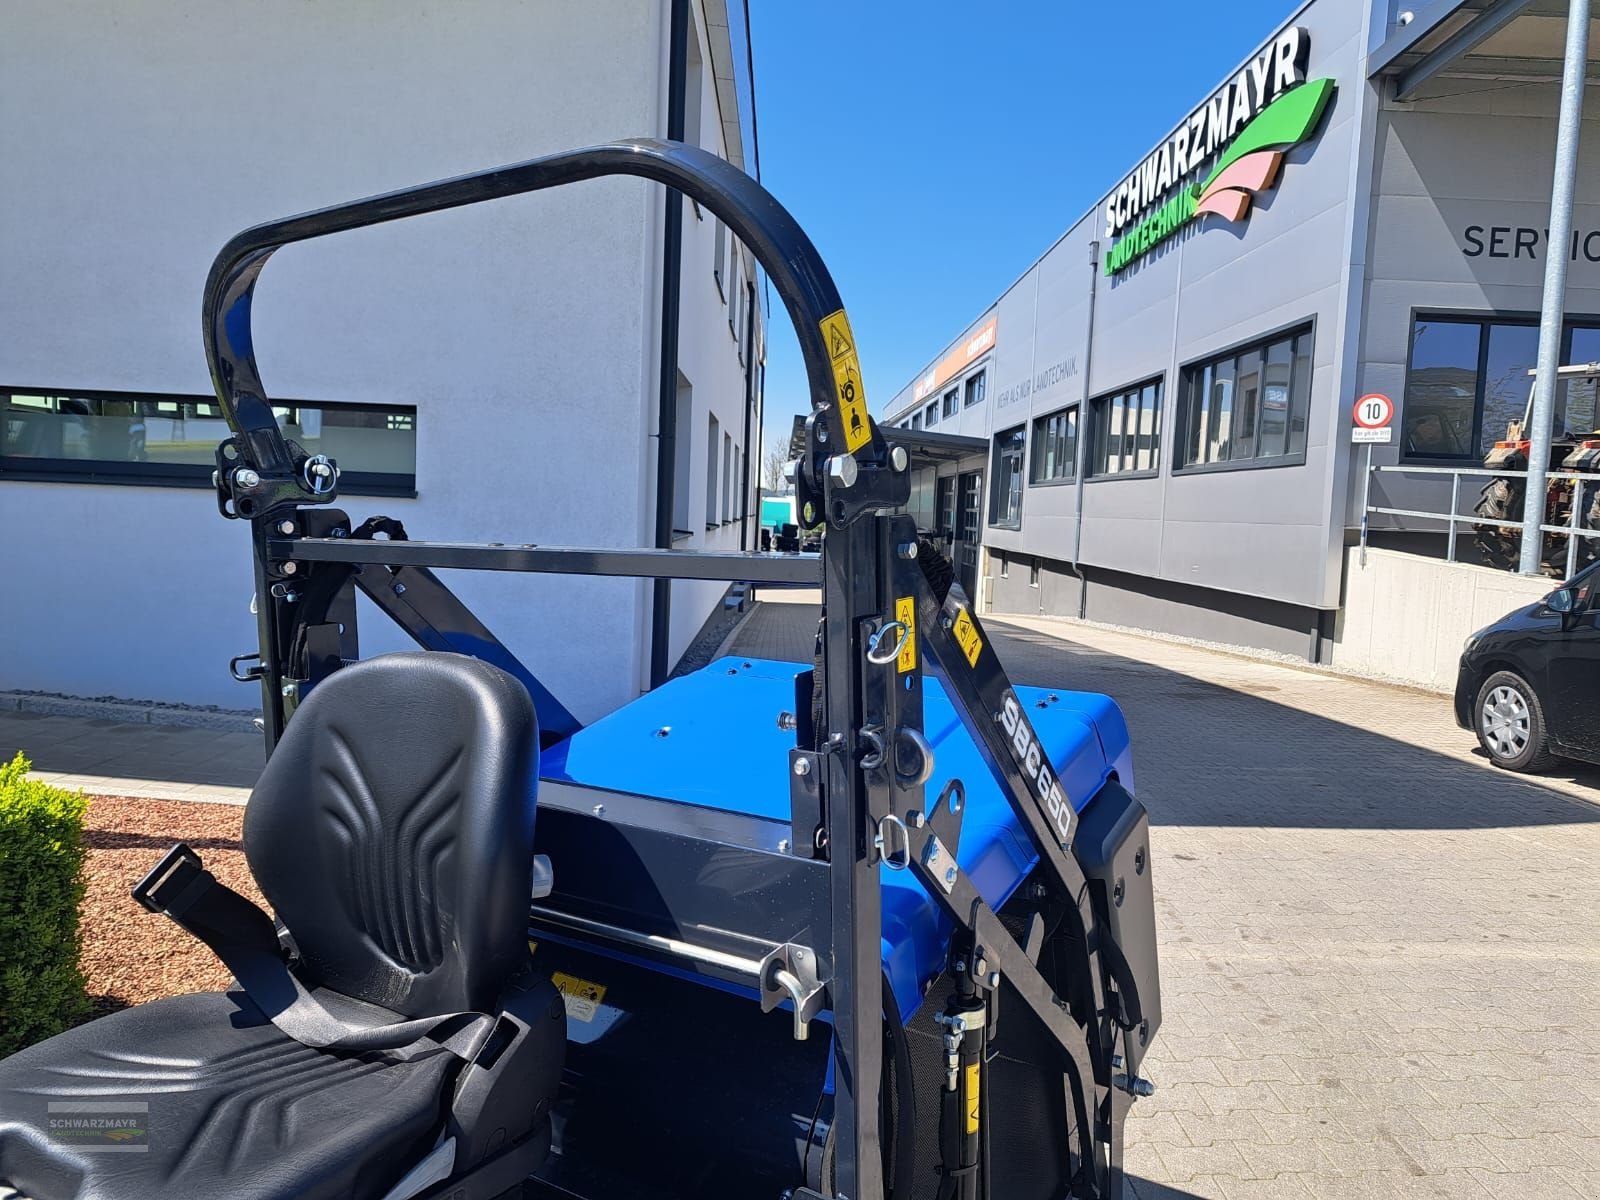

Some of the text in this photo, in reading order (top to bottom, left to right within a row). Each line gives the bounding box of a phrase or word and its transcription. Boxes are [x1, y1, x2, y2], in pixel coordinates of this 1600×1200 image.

[1104, 26, 1306, 238] SCHWARZMAYR
[1104, 185, 1199, 277] LANDTECHNIK
[1462, 225, 1600, 262] SERIC
[1366, 403, 1381, 420] 10
